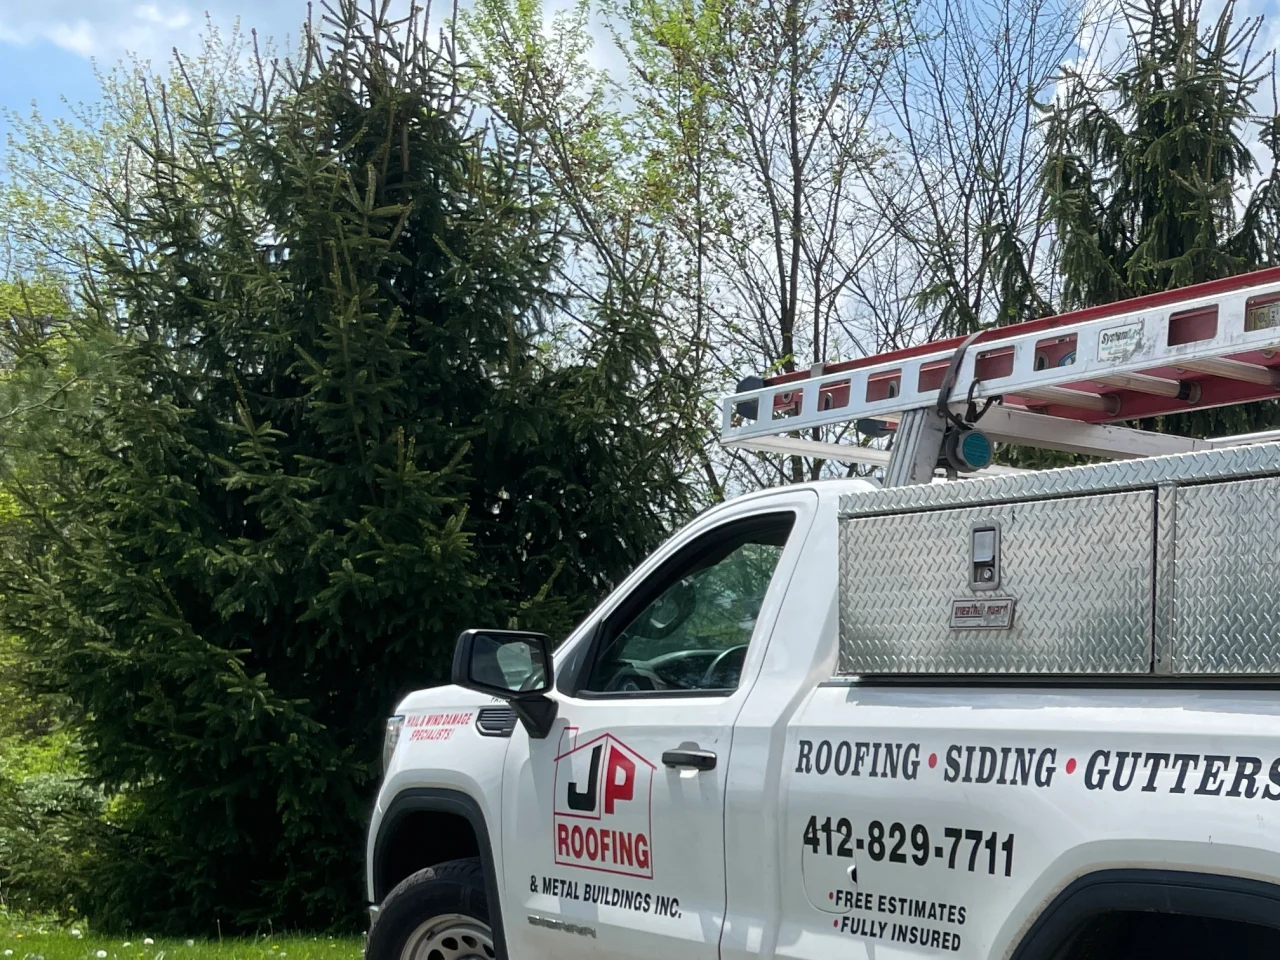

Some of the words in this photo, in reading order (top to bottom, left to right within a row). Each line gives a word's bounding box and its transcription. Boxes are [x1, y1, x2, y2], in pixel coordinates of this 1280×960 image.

[405, 715, 421, 728] HAIL
[425, 713, 445, 727] WIND
[441, 712, 474, 727] DAMAGE
[566, 743, 637, 815] JP
[795, 739, 921, 780] ROOFING
[944, 744, 1058, 788] SIDING
[557, 823, 651, 870] ROOFING
[803, 815, 1015, 878] 412-829-7711
[529, 874, 539, 894] &
[542, 876, 580, 901] METAL
[583, 883, 652, 914] BUILDINGS
[654, 895, 683, 919] INC.
[835, 889, 874, 911] FREE
[877, 894, 967, 925] ESTIMATES
[840, 916, 888, 939] FULLY
[890, 923, 962, 952] INSURED
